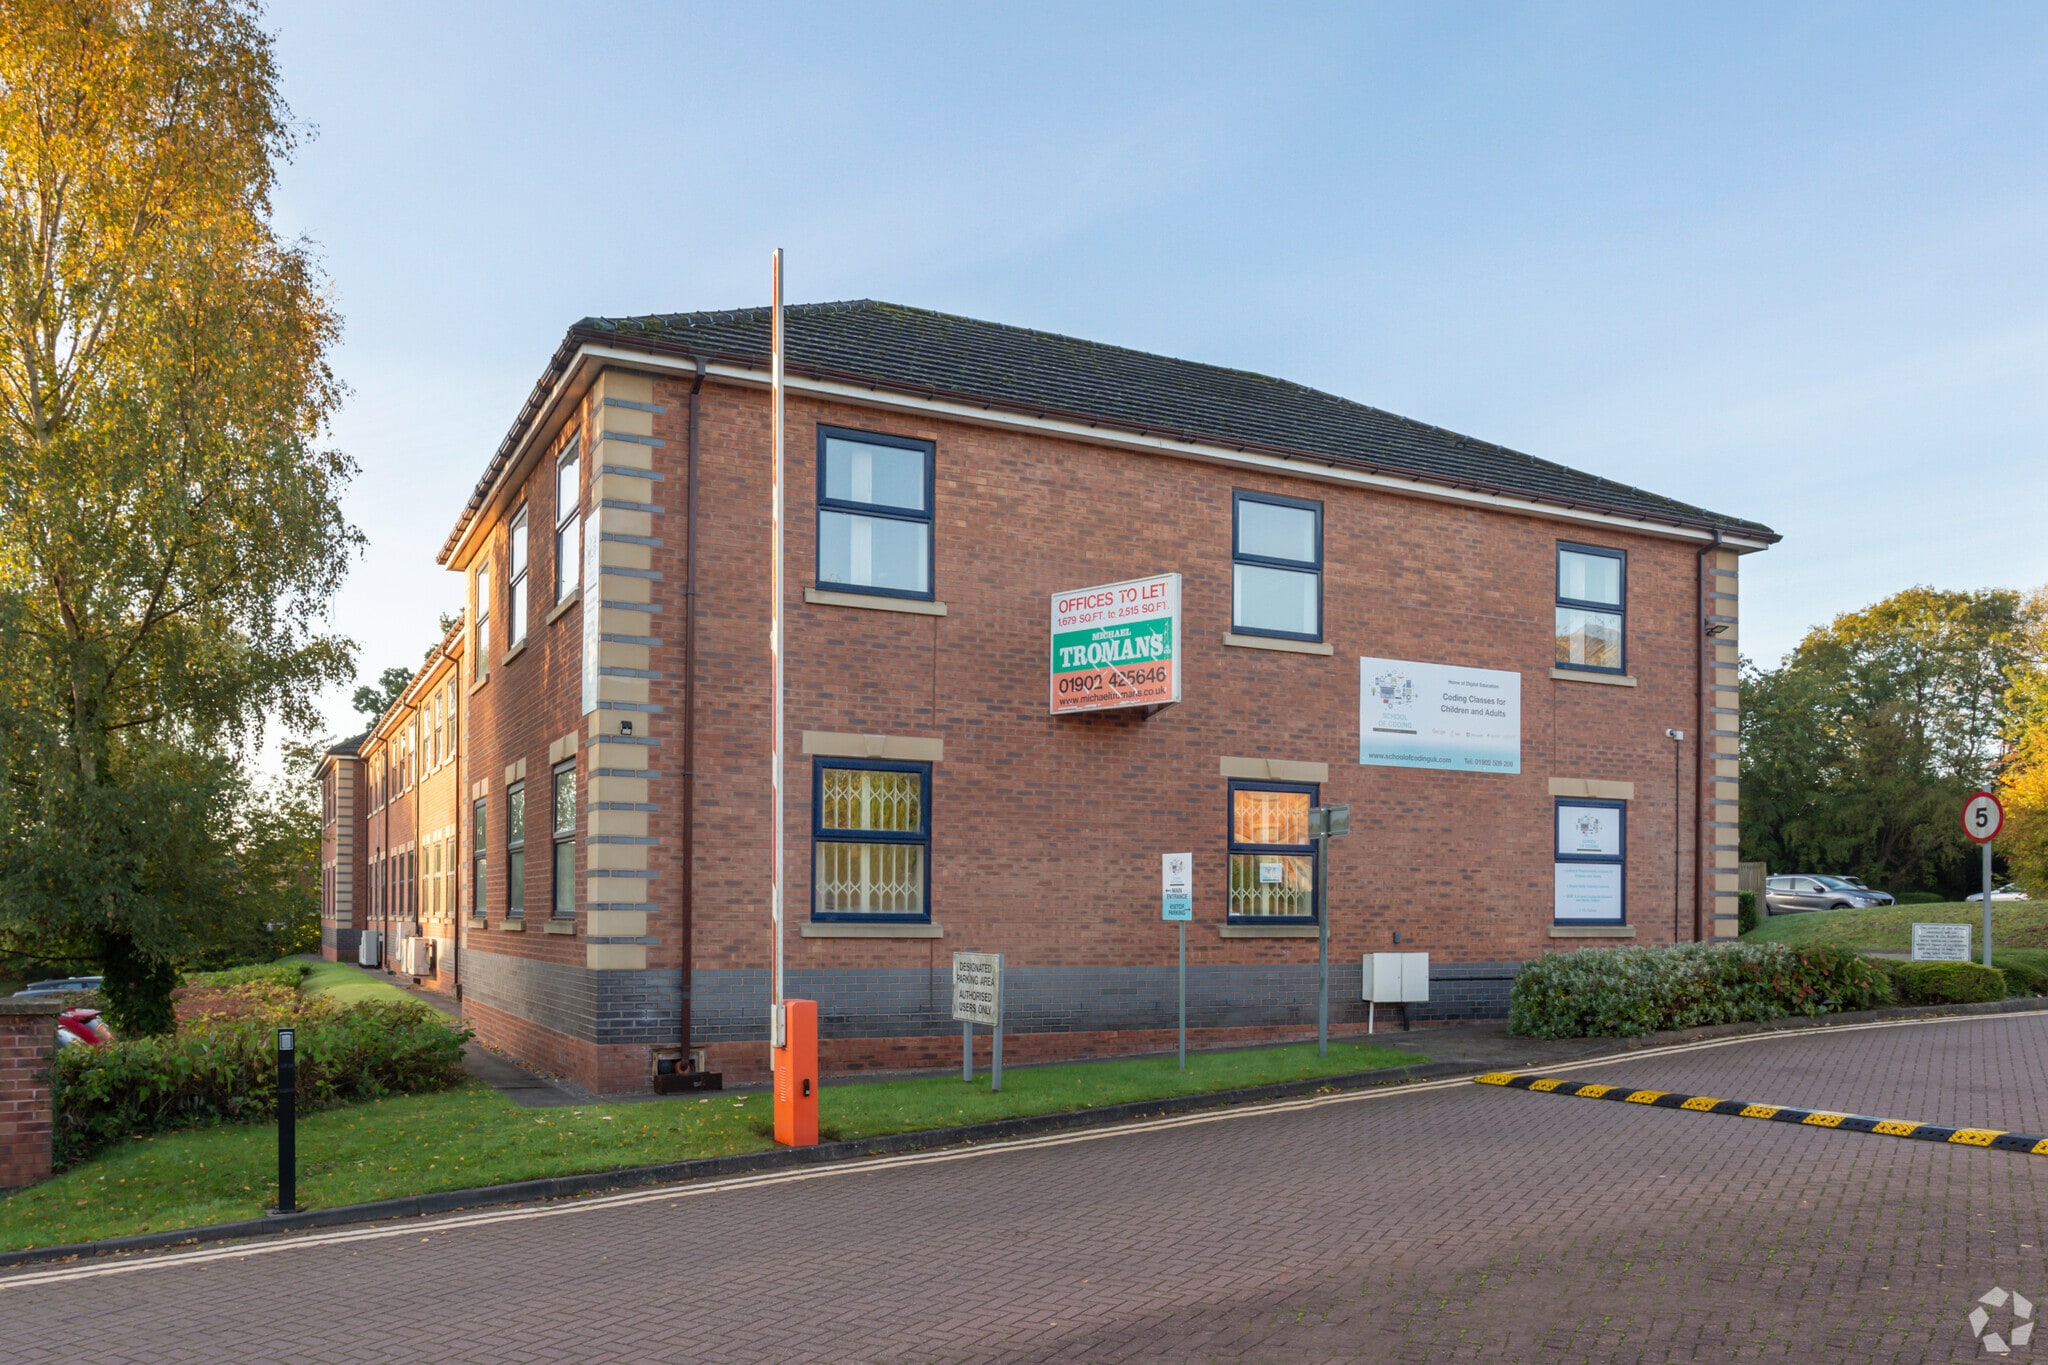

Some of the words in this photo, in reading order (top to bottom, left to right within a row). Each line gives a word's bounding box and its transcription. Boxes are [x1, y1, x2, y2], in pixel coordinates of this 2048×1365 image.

[1059, 592, 1113, 614] OFFICES
[1119, 588, 1137, 603] TO
[1142, 583, 1166, 599] LET
[1058, 616, 1076, 627] 1,679
[1108, 610, 1116, 619] to
[1119, 606, 1139, 617] 2,515
[1092, 628, 1131, 641] MICHAEL
[1060, 633, 1164, 668] TROMANS
[1059, 674, 1102, 694] 01902
[1108, 666, 1166, 687] 425646
[1059, 686, 1166, 705] www.michaeltromans.co.uk
[1443, 693, 1467, 704] Coding
[1469, 695, 1495, 705] Classes
[1496, 698, 1506, 706] for
[1440, 705, 1469, 715] Children
[1471, 708, 1484, 716] and
[1485, 709, 1506, 718] Adults
[1976, 807, 1988, 827] 5
[959, 962, 992, 973] DESIGNATED
[957, 974, 978, 985] PARKING
[980, 976, 994, 987] AREA
[959, 990, 992, 1003] AUTHORISED
[959, 1002, 976, 1013] USERS
[978, 1004, 992, 1015] ONLY
